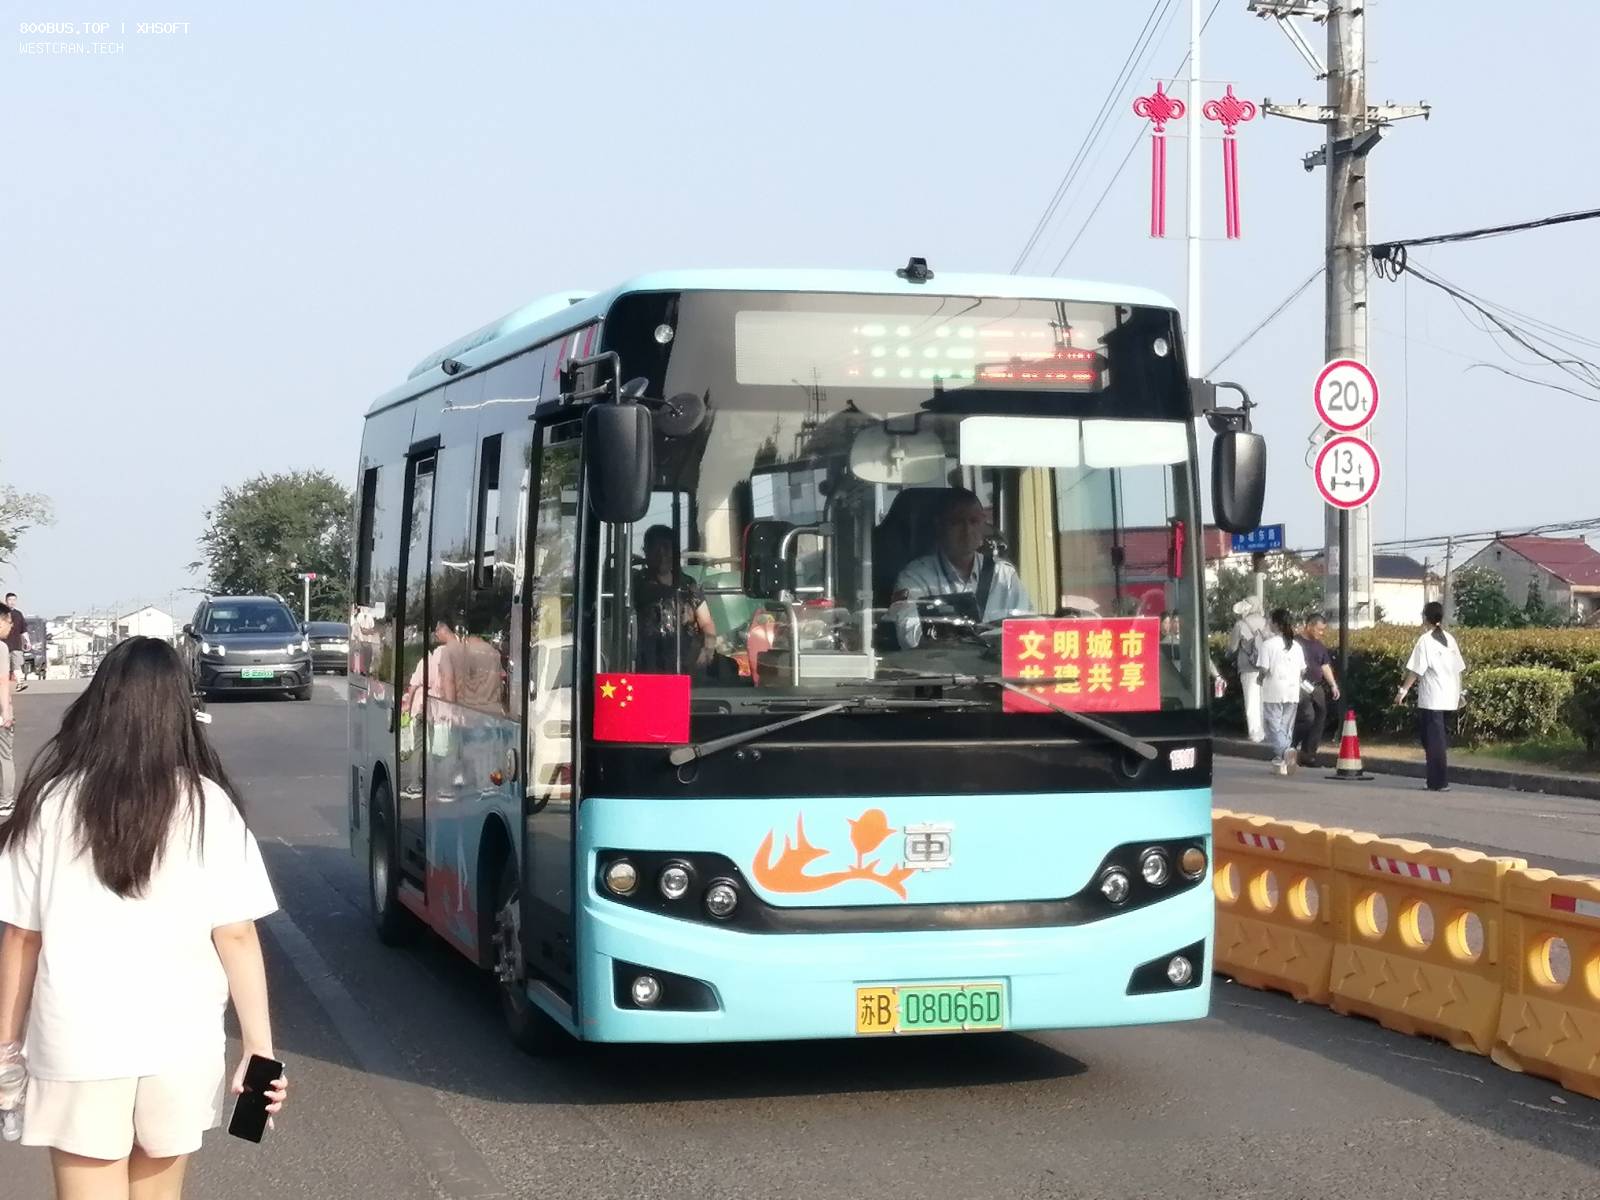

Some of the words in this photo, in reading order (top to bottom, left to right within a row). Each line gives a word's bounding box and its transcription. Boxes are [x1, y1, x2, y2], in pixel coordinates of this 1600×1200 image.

[1018, 628, 1146, 661] 文明城市
[1018, 661, 1146, 694] 共建共享
